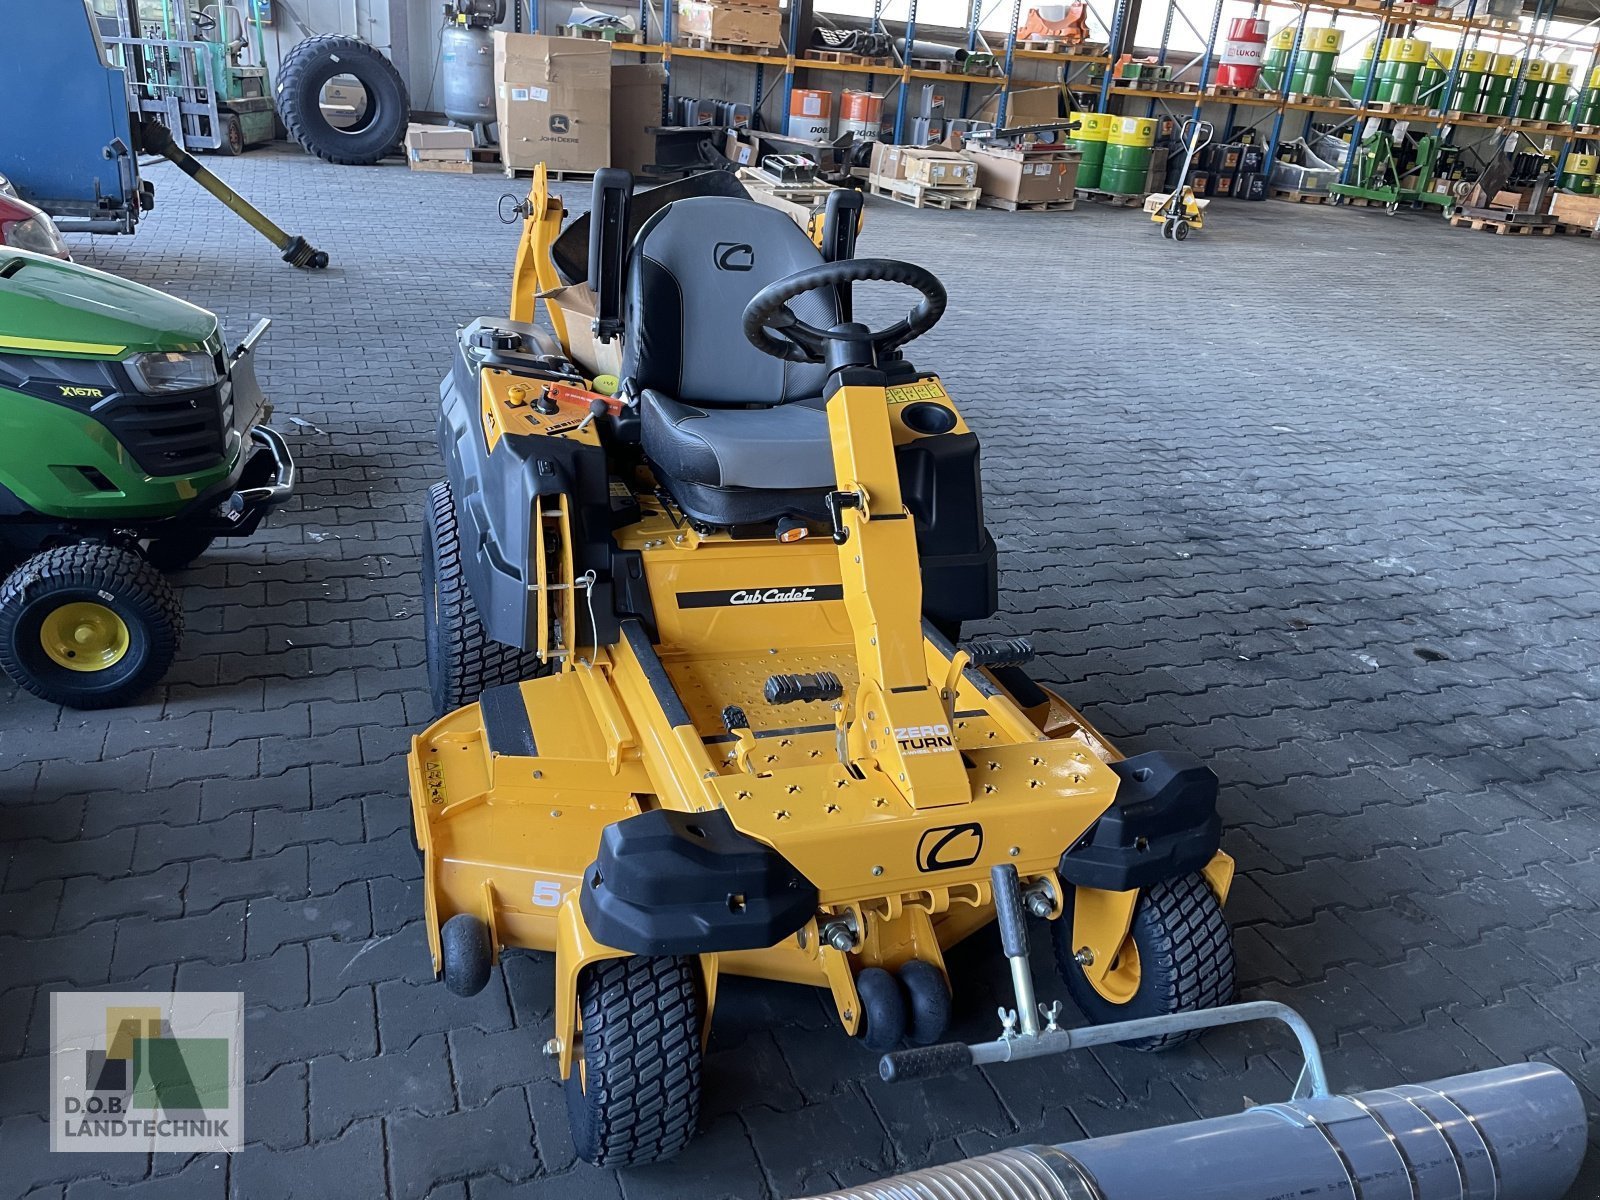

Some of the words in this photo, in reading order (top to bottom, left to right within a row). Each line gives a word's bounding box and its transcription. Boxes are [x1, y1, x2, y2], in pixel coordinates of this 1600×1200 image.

[1236, 49, 1261, 58] LUKOIL
[59, 385, 104, 398] X167R
[729, 590, 762, 605] Cub
[762, 587, 816, 603] Cadet
[894, 724, 949, 739] ZERO
[898, 736, 952, 750] TURN
[532, 880, 567, 907] 5
